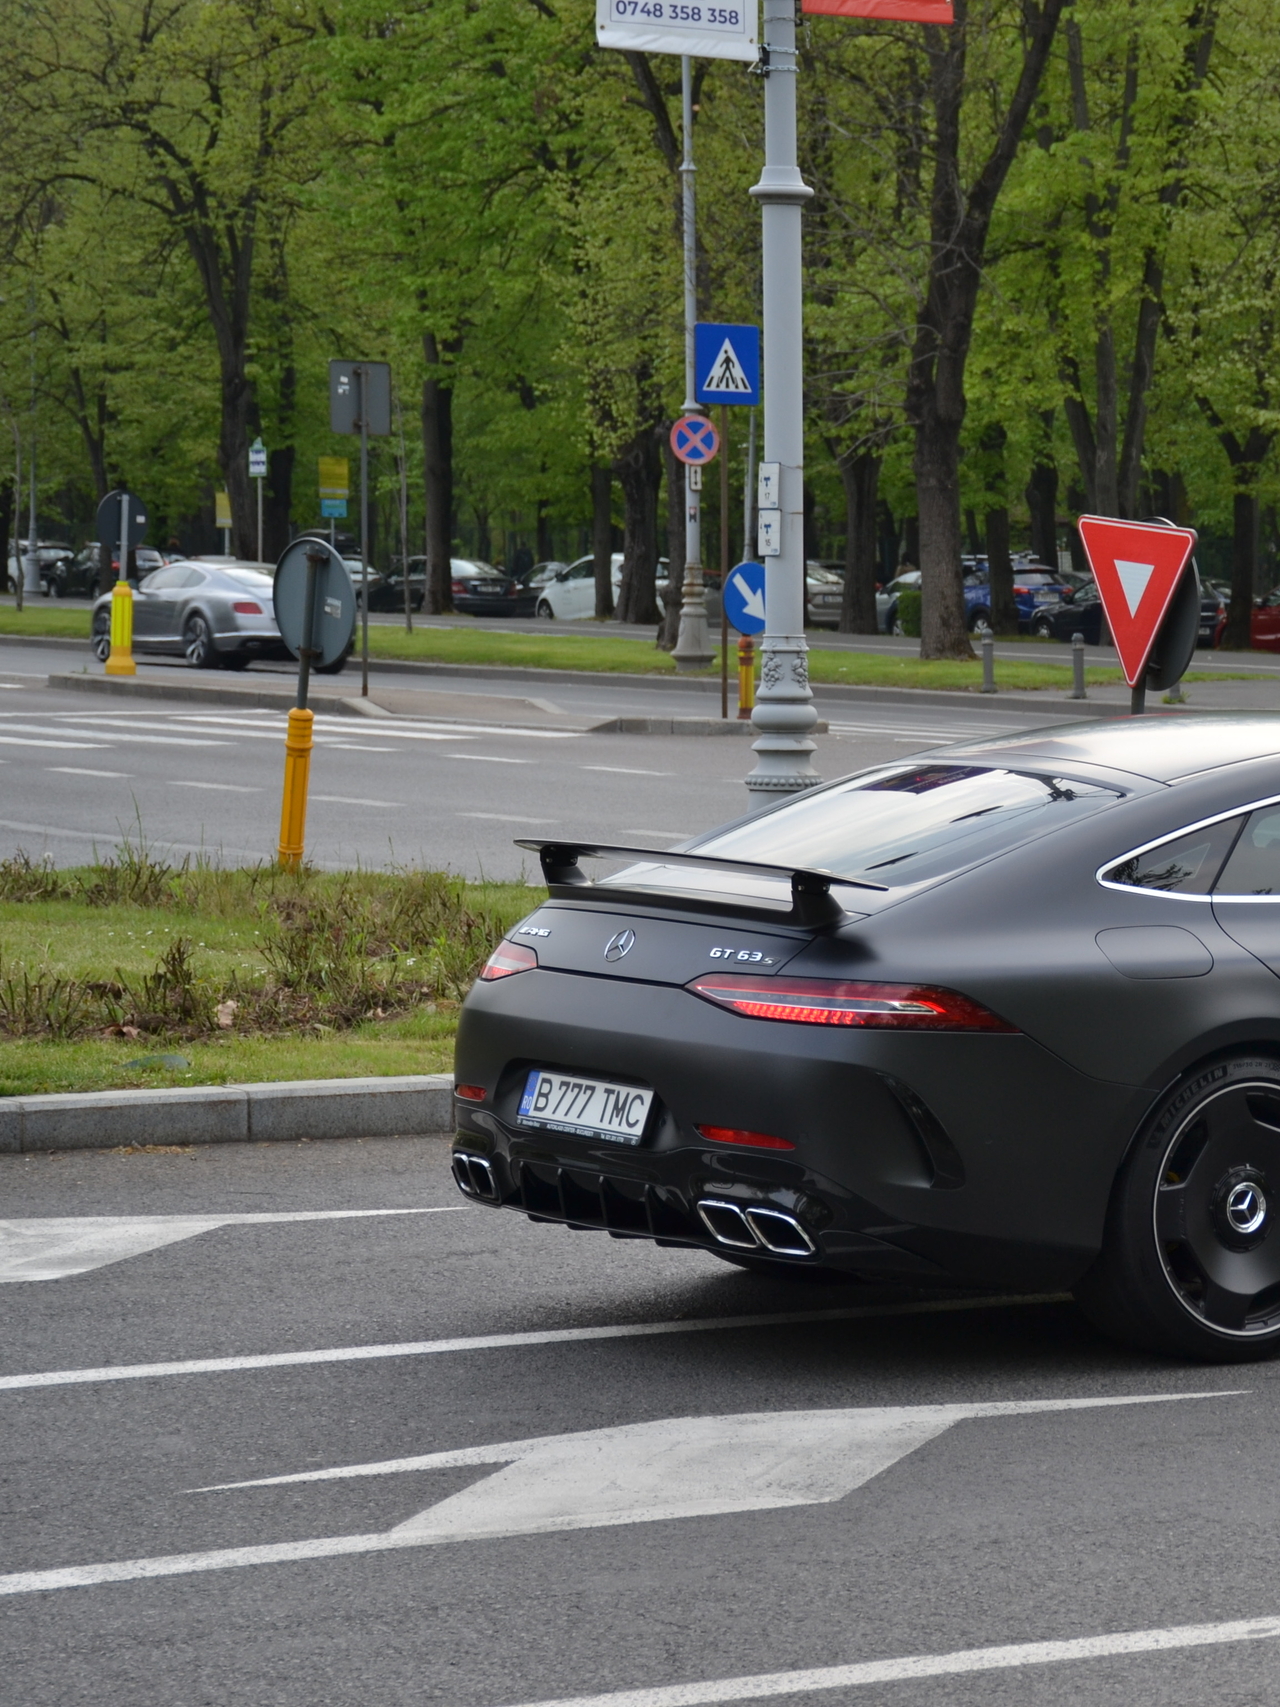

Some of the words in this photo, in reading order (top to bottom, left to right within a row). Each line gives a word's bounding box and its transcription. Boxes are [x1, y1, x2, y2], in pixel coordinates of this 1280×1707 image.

[615, 0, 663, 18] 0748
[668, 4, 702, 22] 358
[707, 8, 739, 25] 358
[709, 947, 735, 959] GT
[737, 950, 763, 962] 63
[521, 1095, 532, 1110] RO
[533, 1077, 553, 1112] B
[552, 1080, 597, 1119] 777
[600, 1087, 644, 1128] TMC
[1161, 1067, 1224, 1127] MICHELIN
